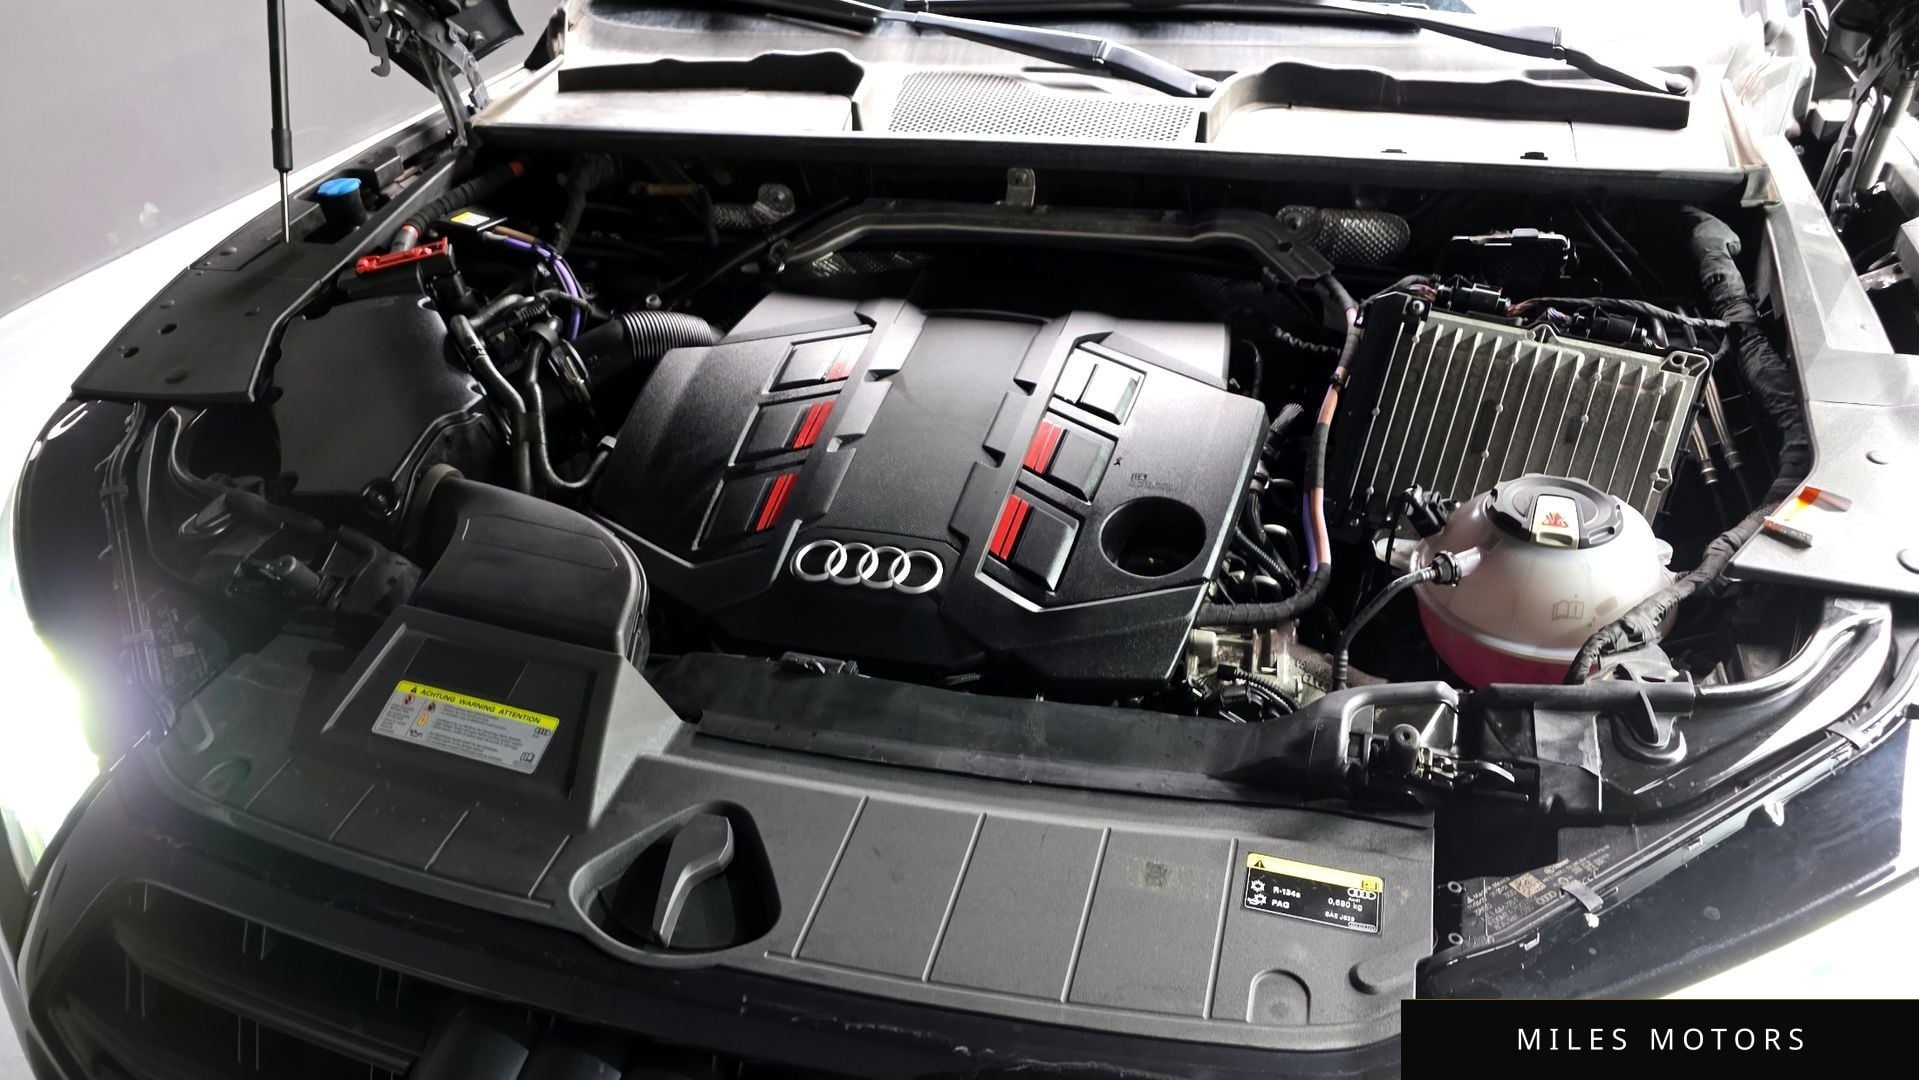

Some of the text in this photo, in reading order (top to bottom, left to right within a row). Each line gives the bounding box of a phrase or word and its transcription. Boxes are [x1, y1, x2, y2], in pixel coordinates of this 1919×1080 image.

[420, 689, 456, 703] ACHTUNG
[458, 699, 496, 713] WARNING
[498, 710, 542, 724] ATTENTION
[1272, 886, 1301, 898] R-134a
[1272, 899, 1290, 909] PAG
[1352, 901, 1363, 912] kg
